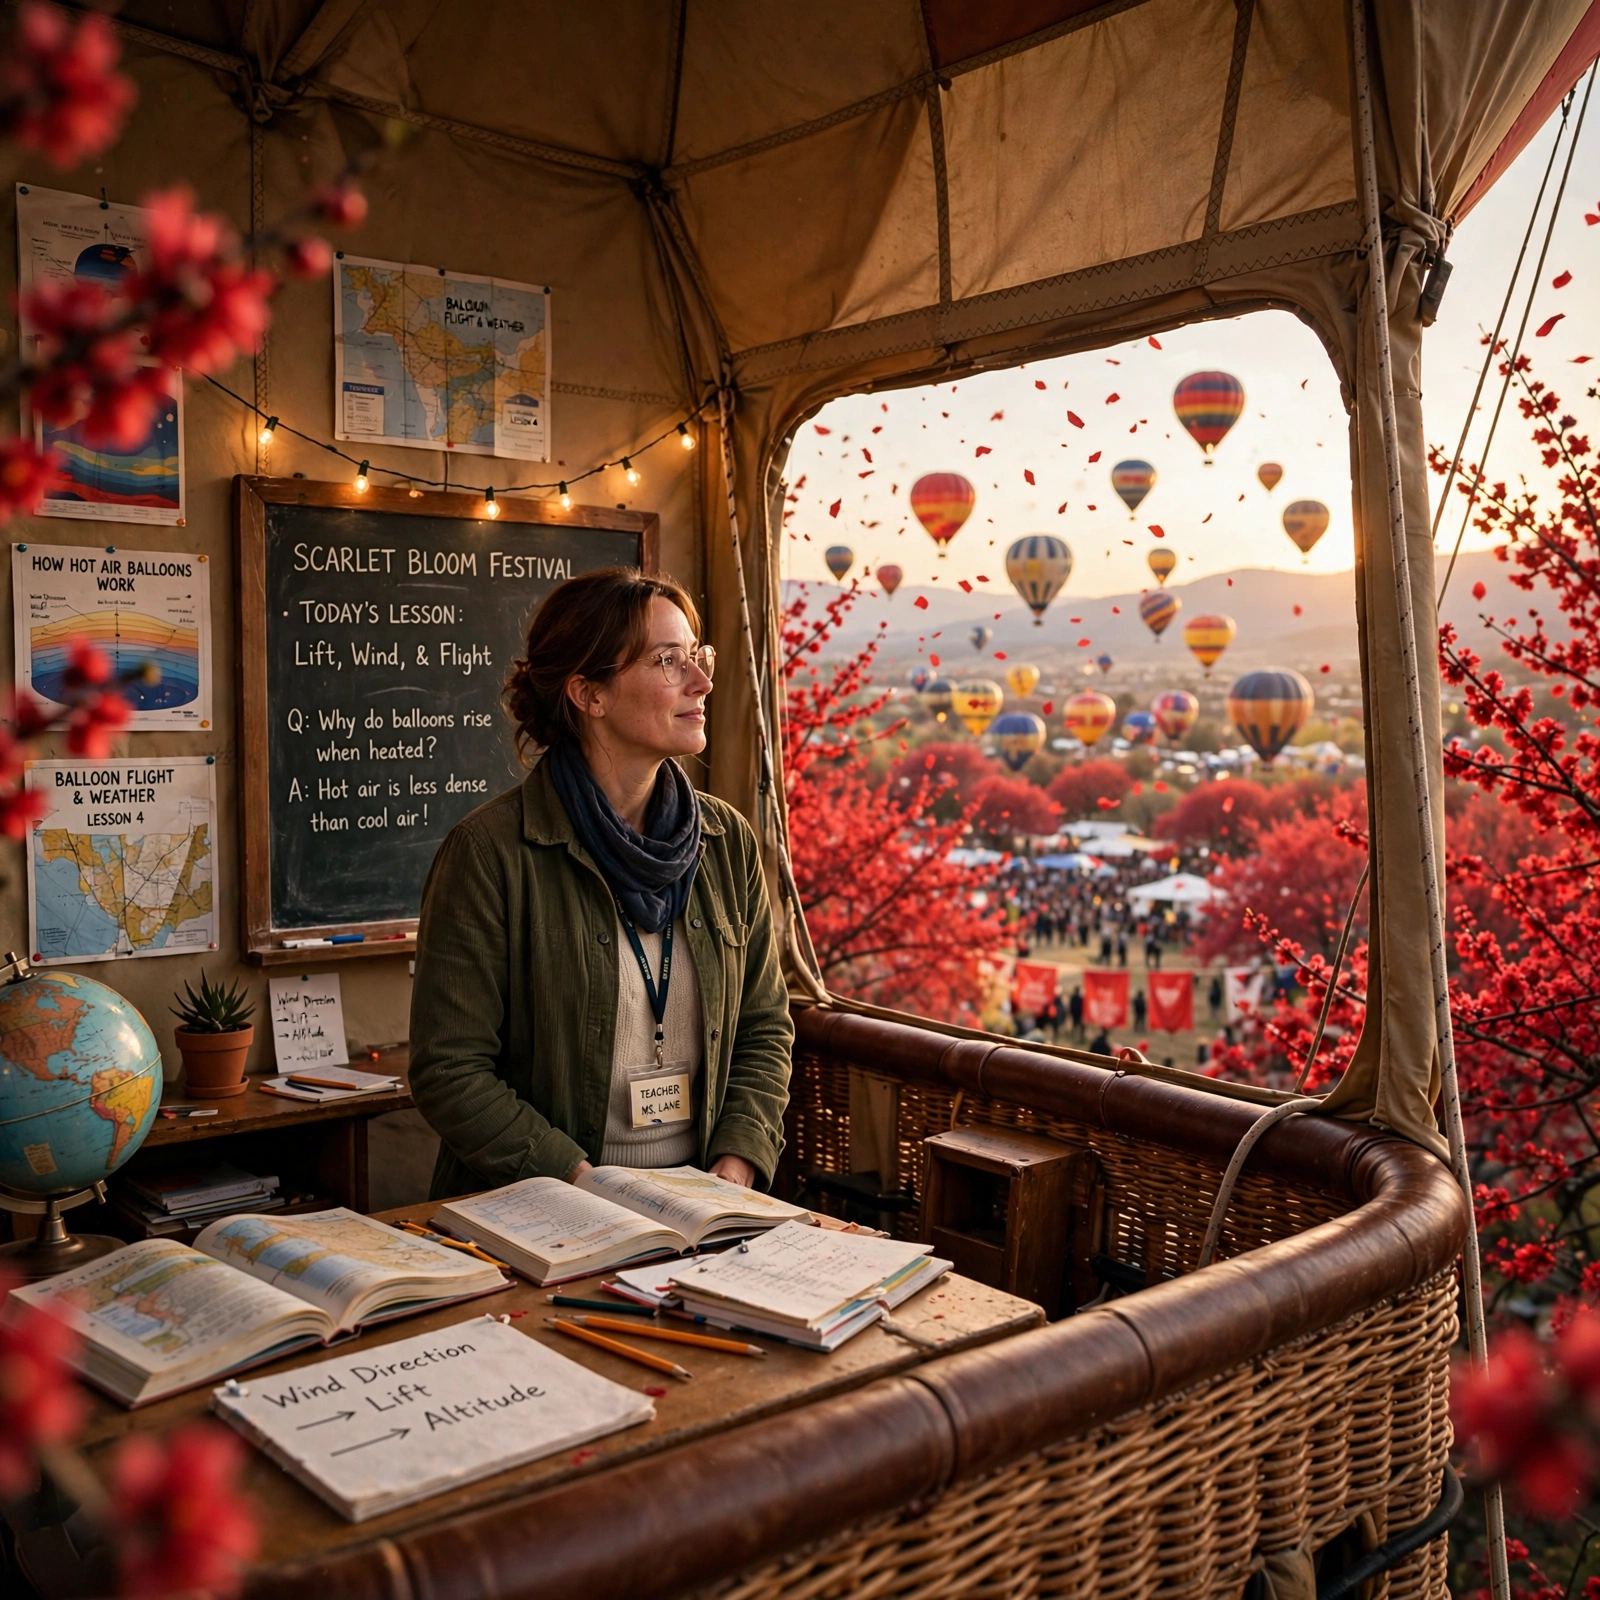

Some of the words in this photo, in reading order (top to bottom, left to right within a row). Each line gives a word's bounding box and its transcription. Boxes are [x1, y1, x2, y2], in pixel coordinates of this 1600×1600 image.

[32, 556, 64, 572] HOW
[70, 558, 97, 573] HOT
[100, 560, 122, 575] AIR
[127, 561, 192, 577] BALLOONS
[294, 543, 396, 573] SCARLET
[408, 549, 477, 576] BLOOM
[490, 552, 576, 580] FESTIVAL
[97, 577, 136, 592] WORK
[299, 600, 379, 624] TODAY'S
[389, 604, 463, 624] LESSON:
[295, 640, 342, 670] Lift,
[351, 642, 405, 670] Wind,
[416, 645, 429, 666] &
[440, 642, 492, 675] Flight
[287, 708, 310, 734] Q:
[318, 709, 355, 739] Why
[364, 708, 384, 729] do
[392, 708, 455, 729] balloons
[463, 710, 492, 727] rise
[316, 741, 360, 762] when
[369, 736, 437, 760] heated?
[55, 771, 120, 786] BALLOON
[127, 769, 175, 785] FLIGHT
[288, 777, 310, 803] A:
[318, 777, 349, 800] Hot
[357, 781, 381, 798] air
[388, 779, 400, 797] is
[409, 774, 437, 795] less
[445, 773, 488, 793] dense
[73, 791, 83, 805] &
[90, 788, 155, 804] WEATHER
[87, 813, 131, 827] LESSON
[136, 811, 144, 824] 4
[310, 811, 349, 832] than
[357, 806, 388, 829] cool
[396, 803, 428, 827] air!
[640, 1084, 680, 1099] TEACHER
[641, 1104, 656, 1116] MS.
[658, 1100, 681, 1113] LANE
[262, 1373, 346, 1410] Wind
[350, 1340, 477, 1386] Direction
[365, 1381, 434, 1413] Lift
[423, 1382, 547, 1432] Altitude
